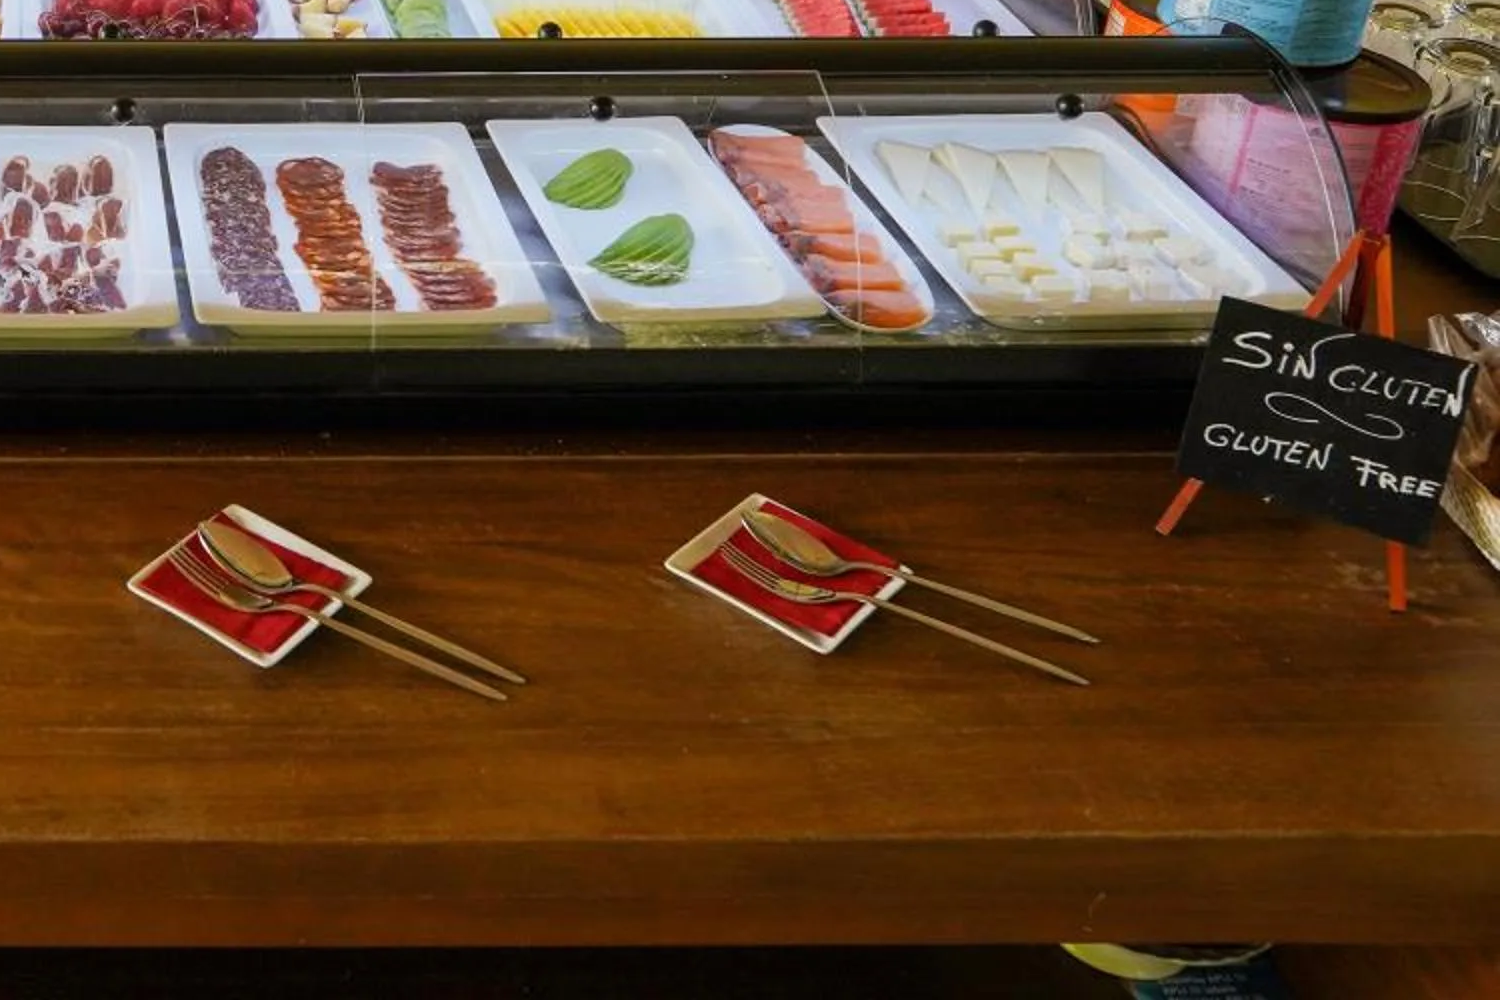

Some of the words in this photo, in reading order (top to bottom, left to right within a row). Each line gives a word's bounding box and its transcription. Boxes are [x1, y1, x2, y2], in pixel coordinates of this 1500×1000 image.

[1328, 363, 1476, 418] GLUTEN
[1203, 423, 1334, 471] GLUTEN
[1350, 455, 1444, 499] FREE
